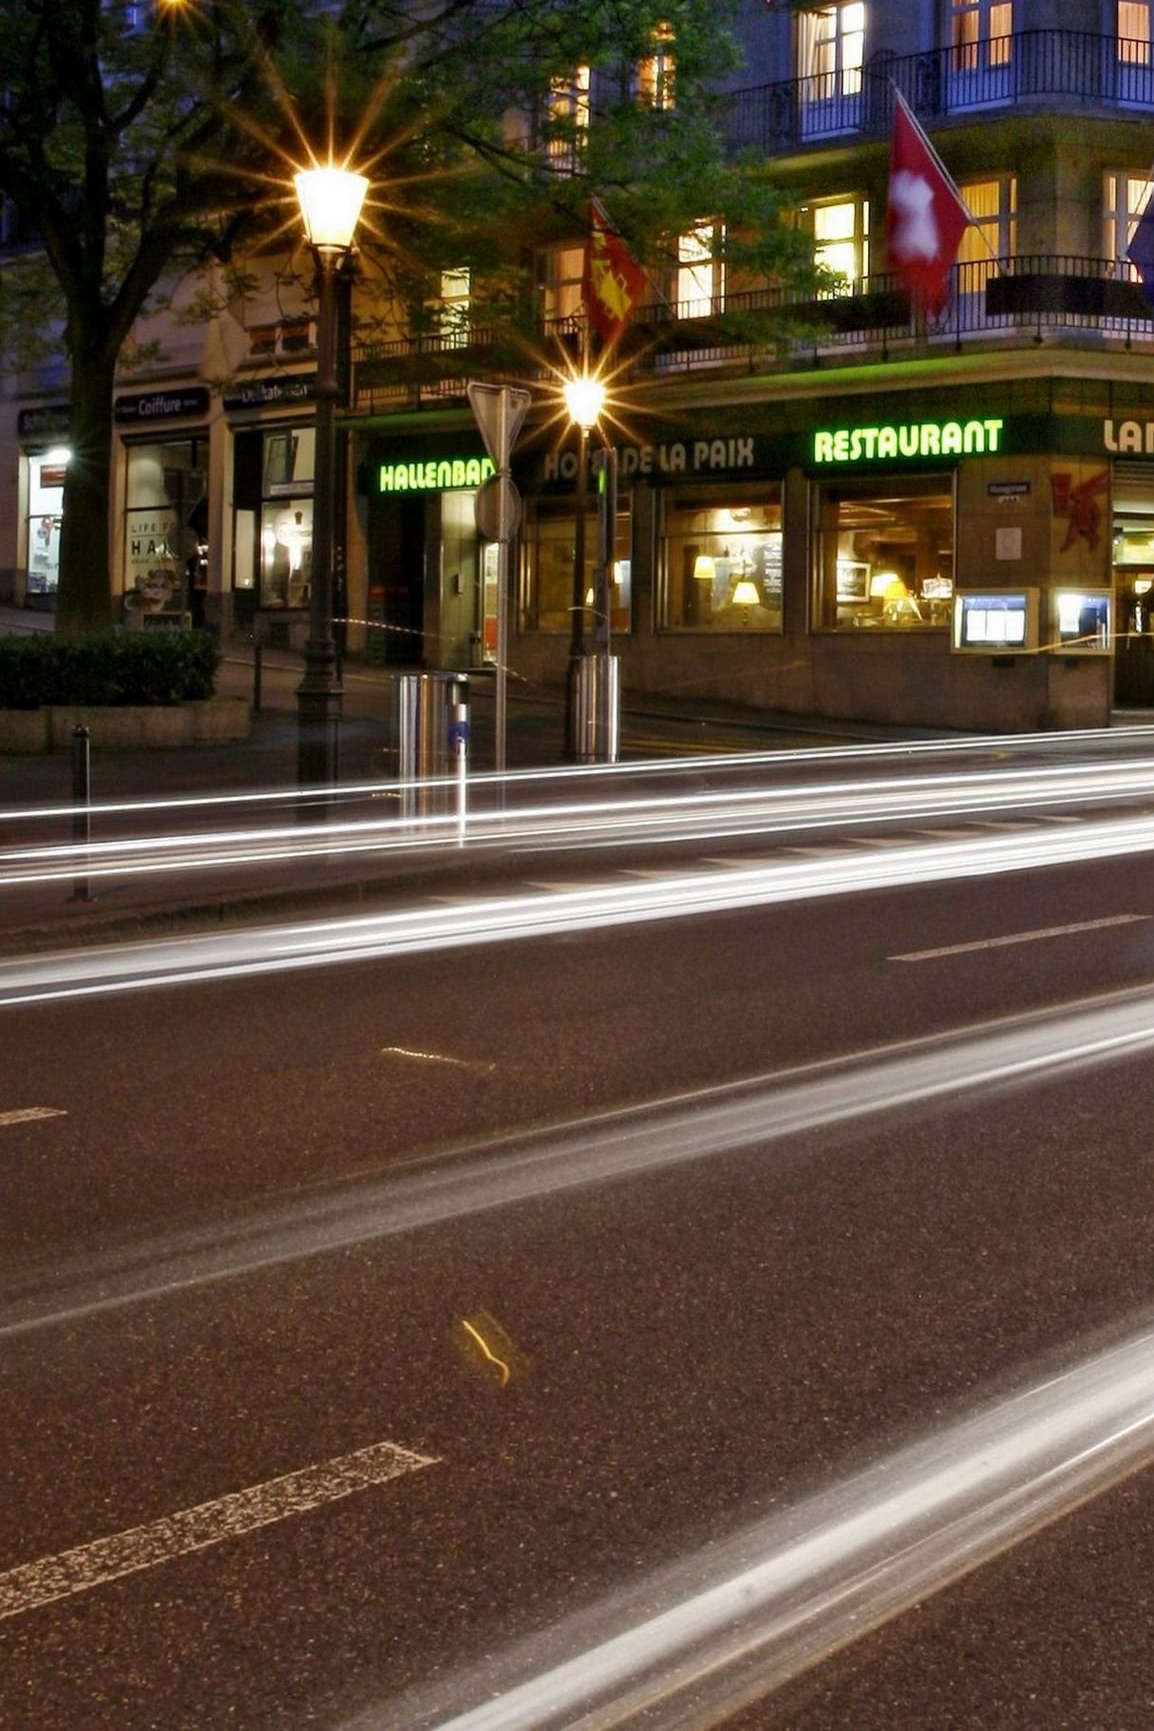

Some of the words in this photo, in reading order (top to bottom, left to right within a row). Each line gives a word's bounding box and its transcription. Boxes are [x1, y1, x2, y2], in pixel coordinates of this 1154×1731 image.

[138, 396, 181, 416] Coiffure
[622, 445, 653, 474] DE
[659, 442, 687, 471] LA
[693, 436, 754, 471] PAIX
[814, 419, 1003, 463] RESTAURANT
